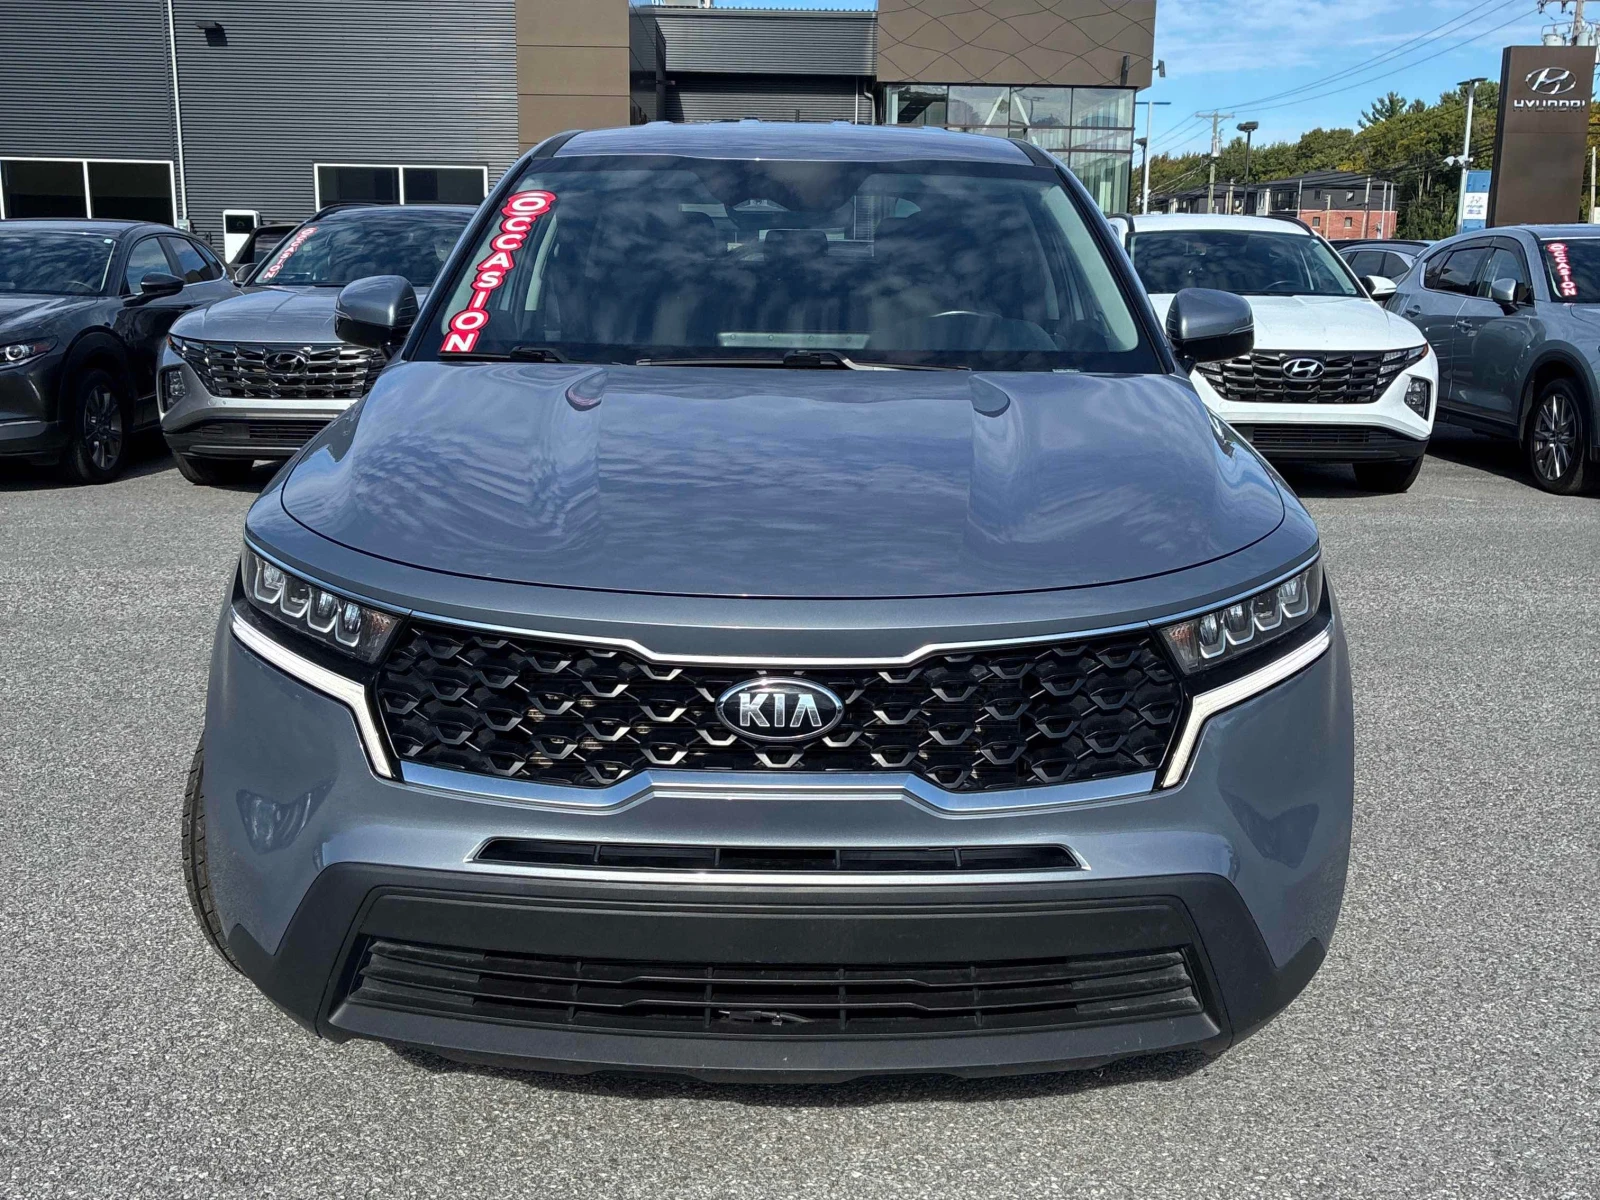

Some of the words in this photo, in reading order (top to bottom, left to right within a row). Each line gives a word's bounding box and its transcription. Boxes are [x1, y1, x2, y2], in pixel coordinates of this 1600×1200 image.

[1513, 99, 1586, 112] HYUNDAI
[442, 192, 552, 352] OCCASION
[738, 693, 822, 727] KIA
